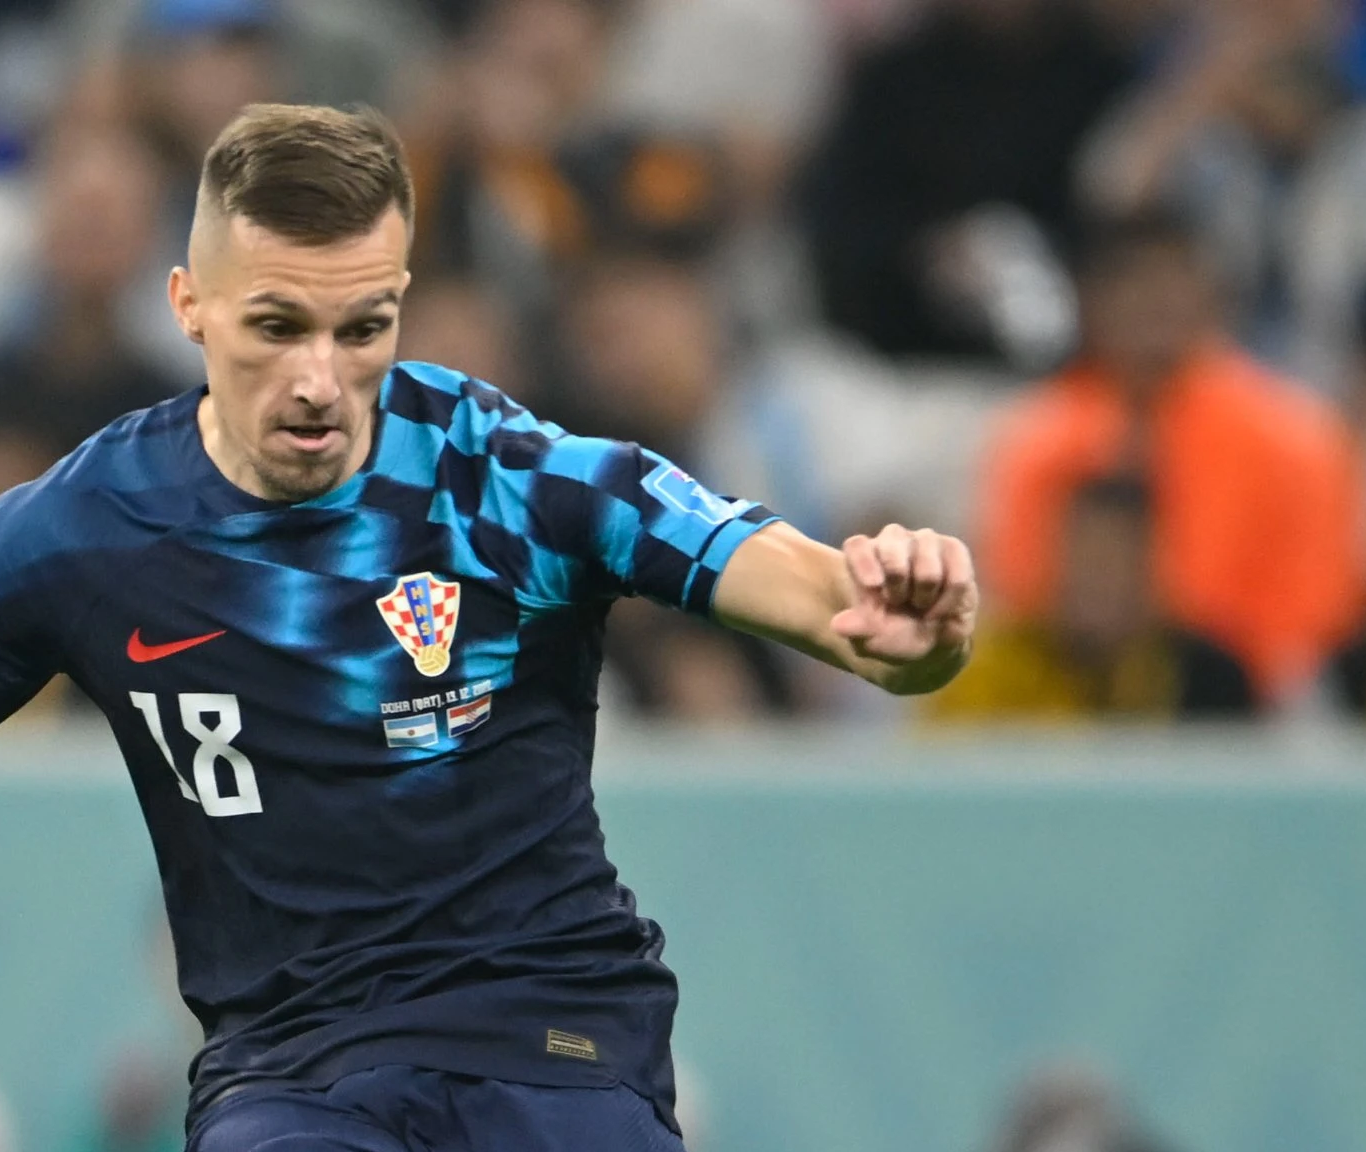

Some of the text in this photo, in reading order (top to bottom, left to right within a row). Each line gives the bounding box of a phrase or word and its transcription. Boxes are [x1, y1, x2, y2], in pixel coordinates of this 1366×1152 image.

[410, 585, 431, 637] HNS
[380, 700, 411, 714] DOHA
[129, 691, 263, 817] 18
